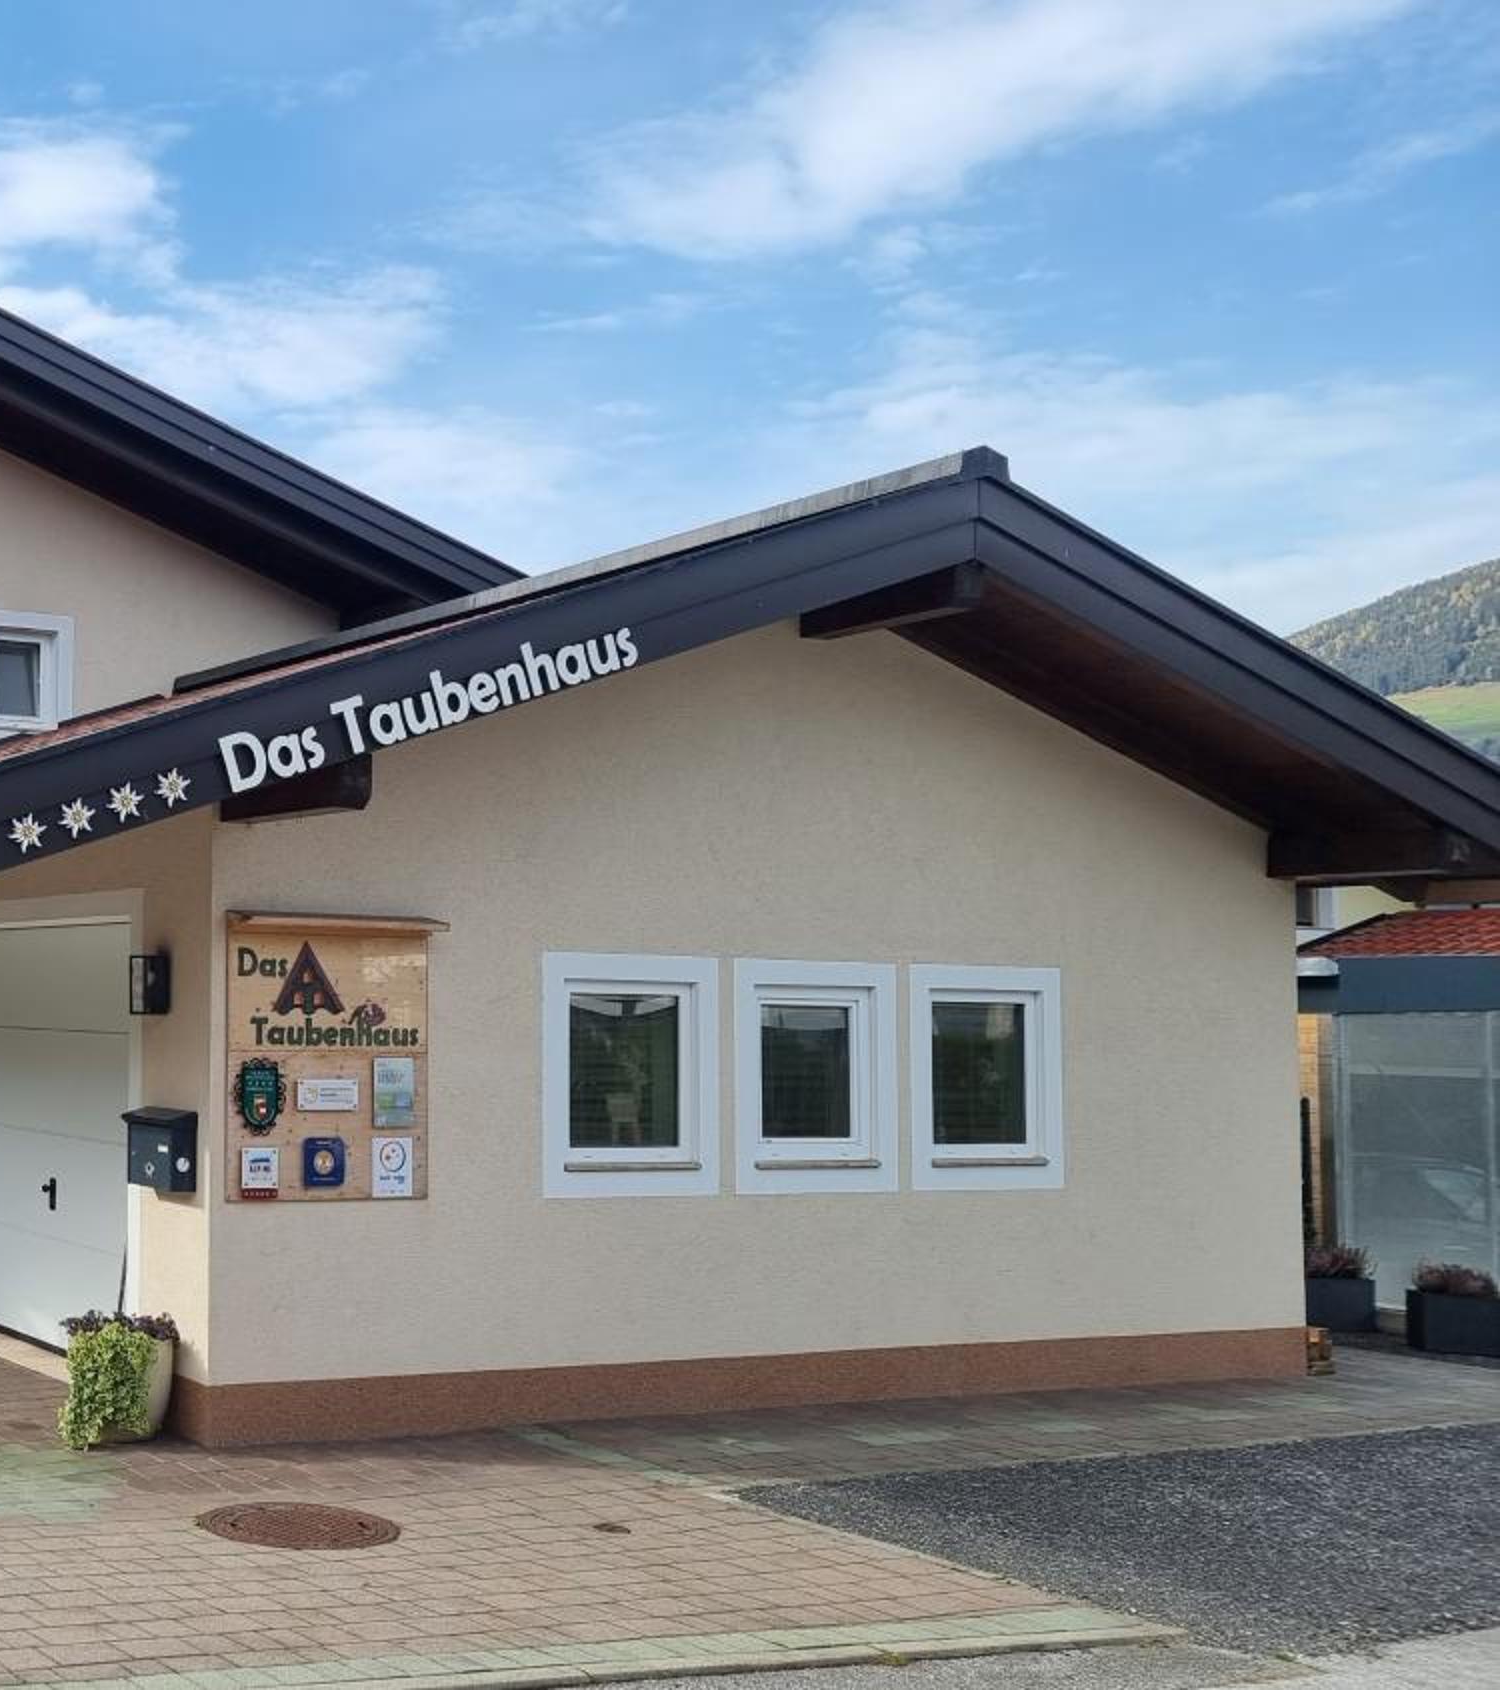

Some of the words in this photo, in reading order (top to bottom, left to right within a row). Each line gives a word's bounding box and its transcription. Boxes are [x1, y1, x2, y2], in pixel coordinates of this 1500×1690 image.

[217, 725, 326, 793] Das
[329, 627, 639, 755] Taubenhaus
[237, 946, 289, 978] Das
